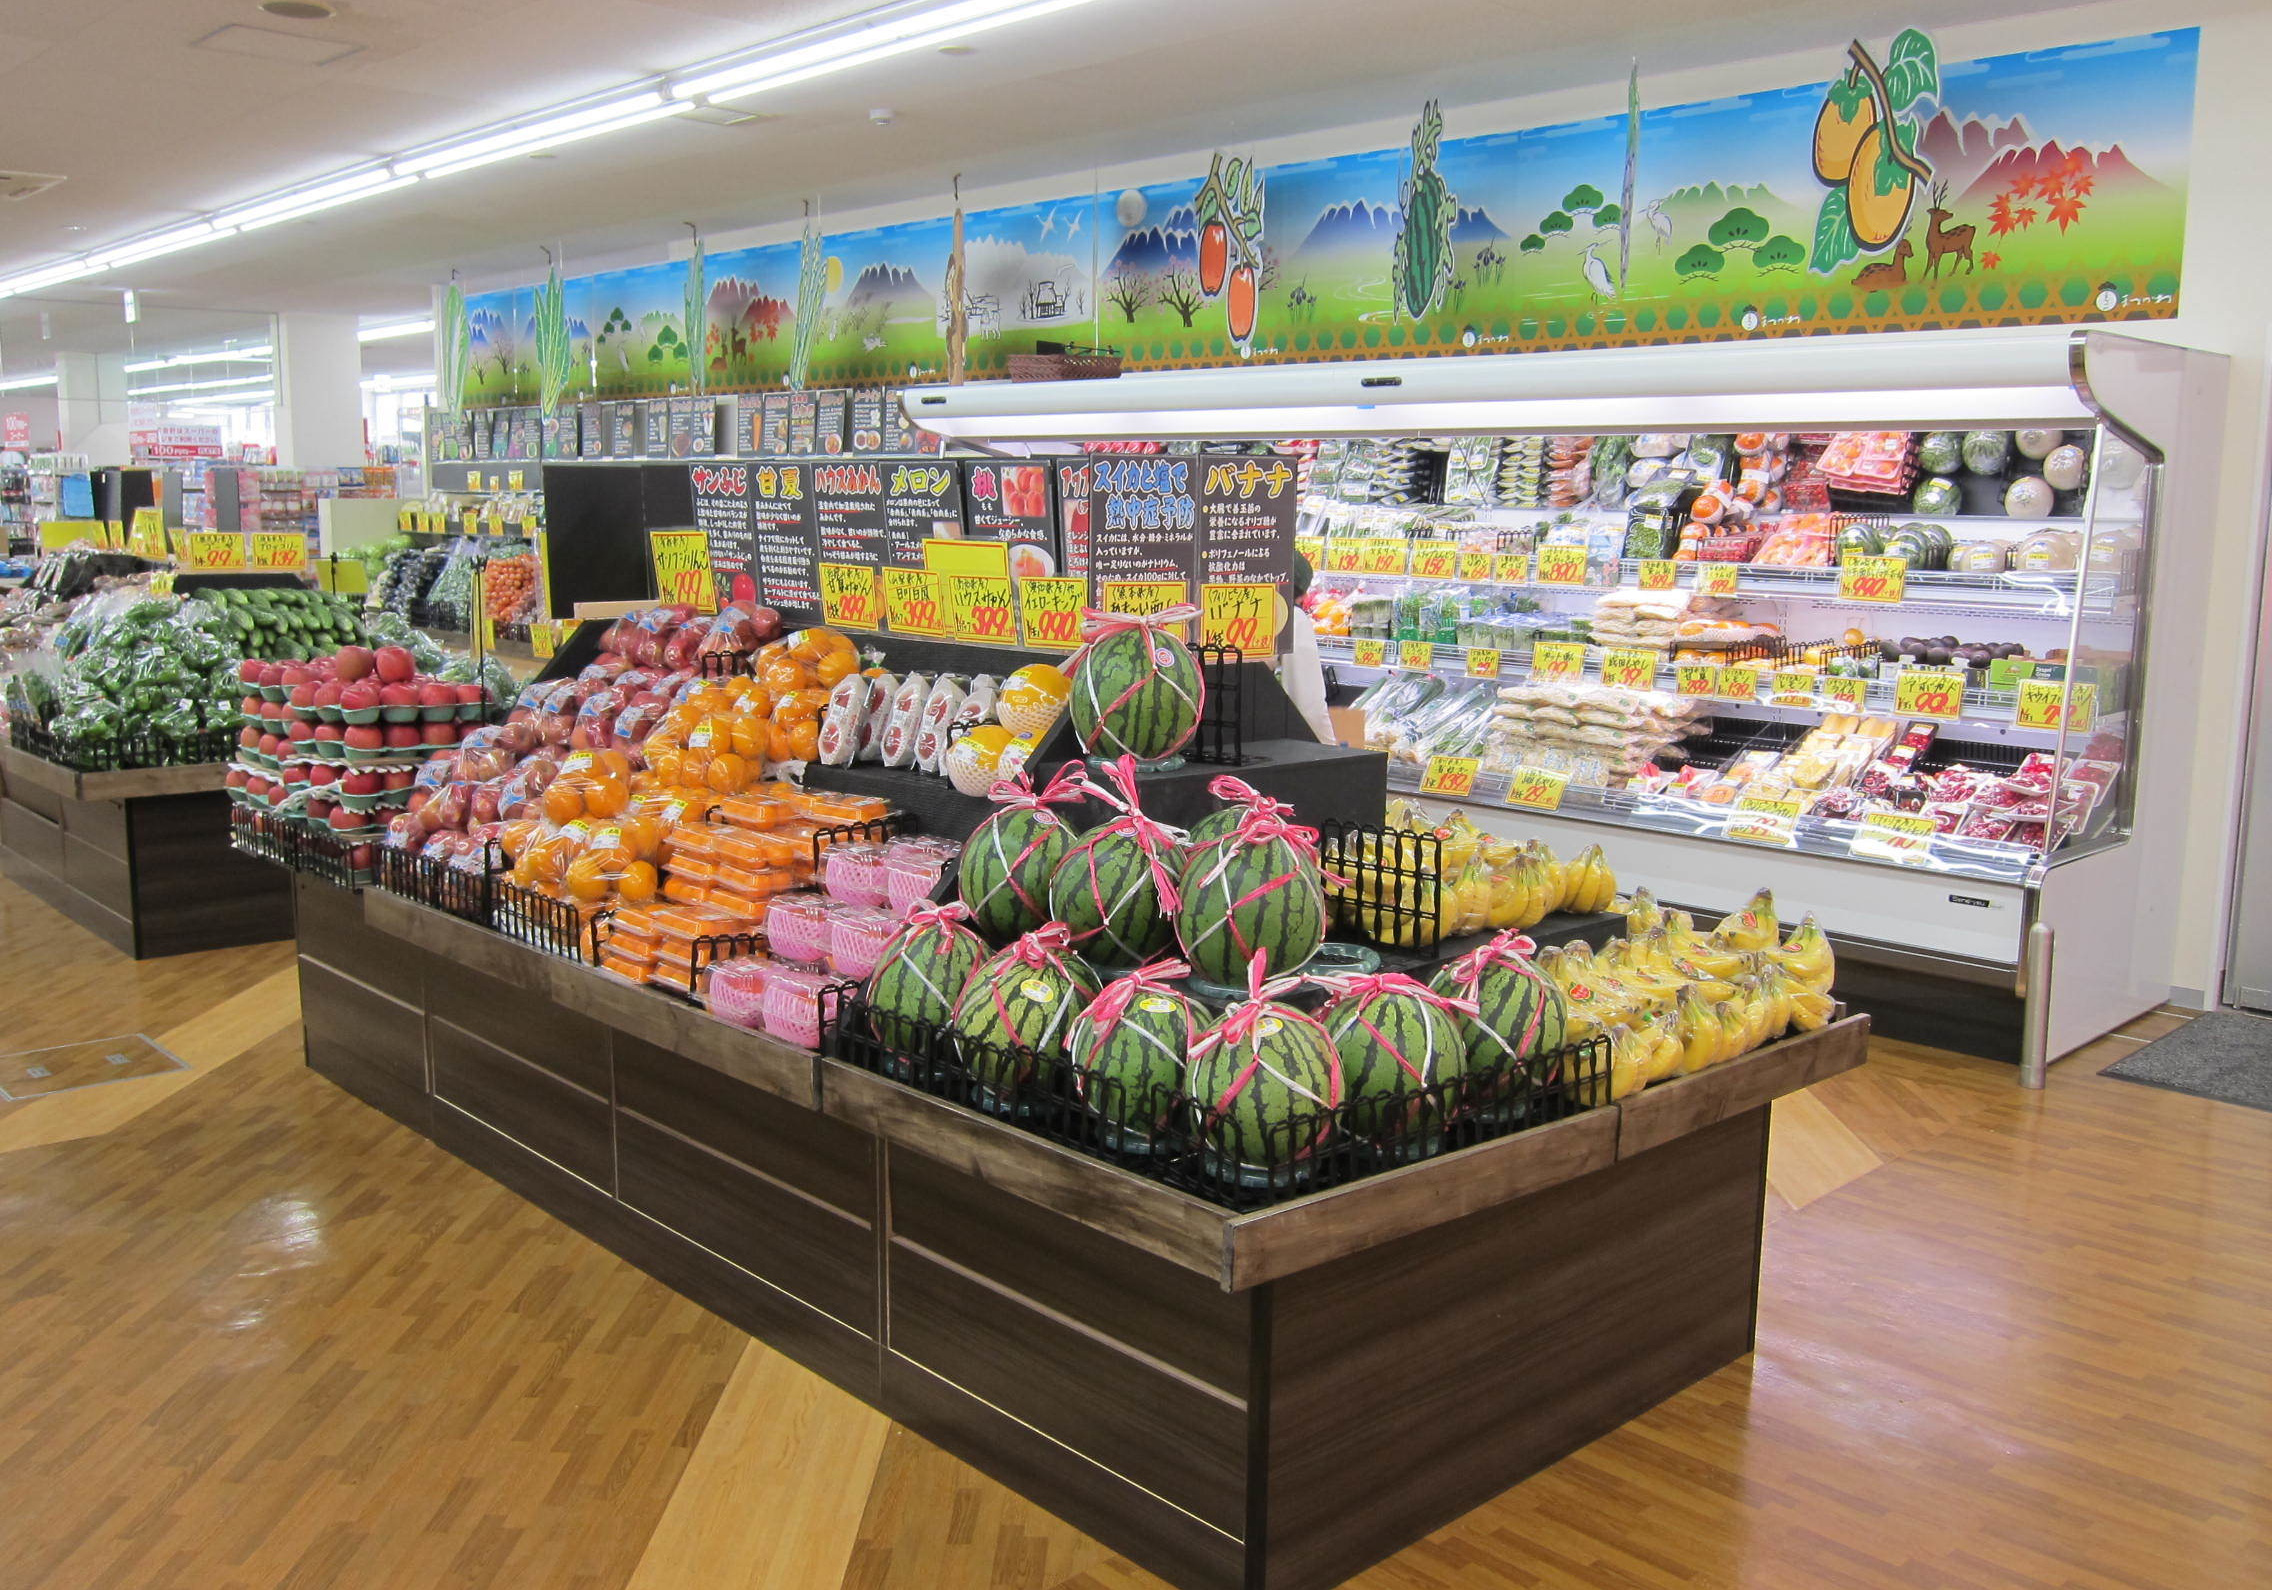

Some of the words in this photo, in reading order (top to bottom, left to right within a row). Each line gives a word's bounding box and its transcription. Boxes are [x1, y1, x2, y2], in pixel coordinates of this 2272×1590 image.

[692, 465, 747, 496] サンふじ
[756, 466, 803, 499] 甘夏
[815, 465, 881, 495] ハウスみかん
[890, 465, 950, 497] メロン
[971, 465, 998, 501] 桃
[1093, 459, 1189, 495] スイカと塩で
[1204, 460, 1293, 498] バナナ
[981, 502, 993, 511] もも
[1105, 493, 1196, 530] 熱中症予防
[1208, 516, 1277, 527] 栄養になるオリゴ糖が
[207, 550, 232, 566] 99
[272, 550, 297, 566] 139
[1208, 549, 1270, 559] ポリフェノールによる
[1338, 554, 1360, 570] 139
[1422, 558, 1445, 575] 159
[1551, 563, 1577, 581] 890
[1853, 575, 1888, 597] 990
[839, 594, 866, 622] 299
[903, 601, 937, 629] 399
[1210, 598, 1262, 619] バナナ
[971, 606, 1009, 636] 399
[1038, 610, 1076, 640] 990
[1226, 618, 1257, 648] 99
[1620, 668, 1643, 686] 39
[1437, 773, 1468, 790] 139
[1521, 786, 1548, 802] 29
